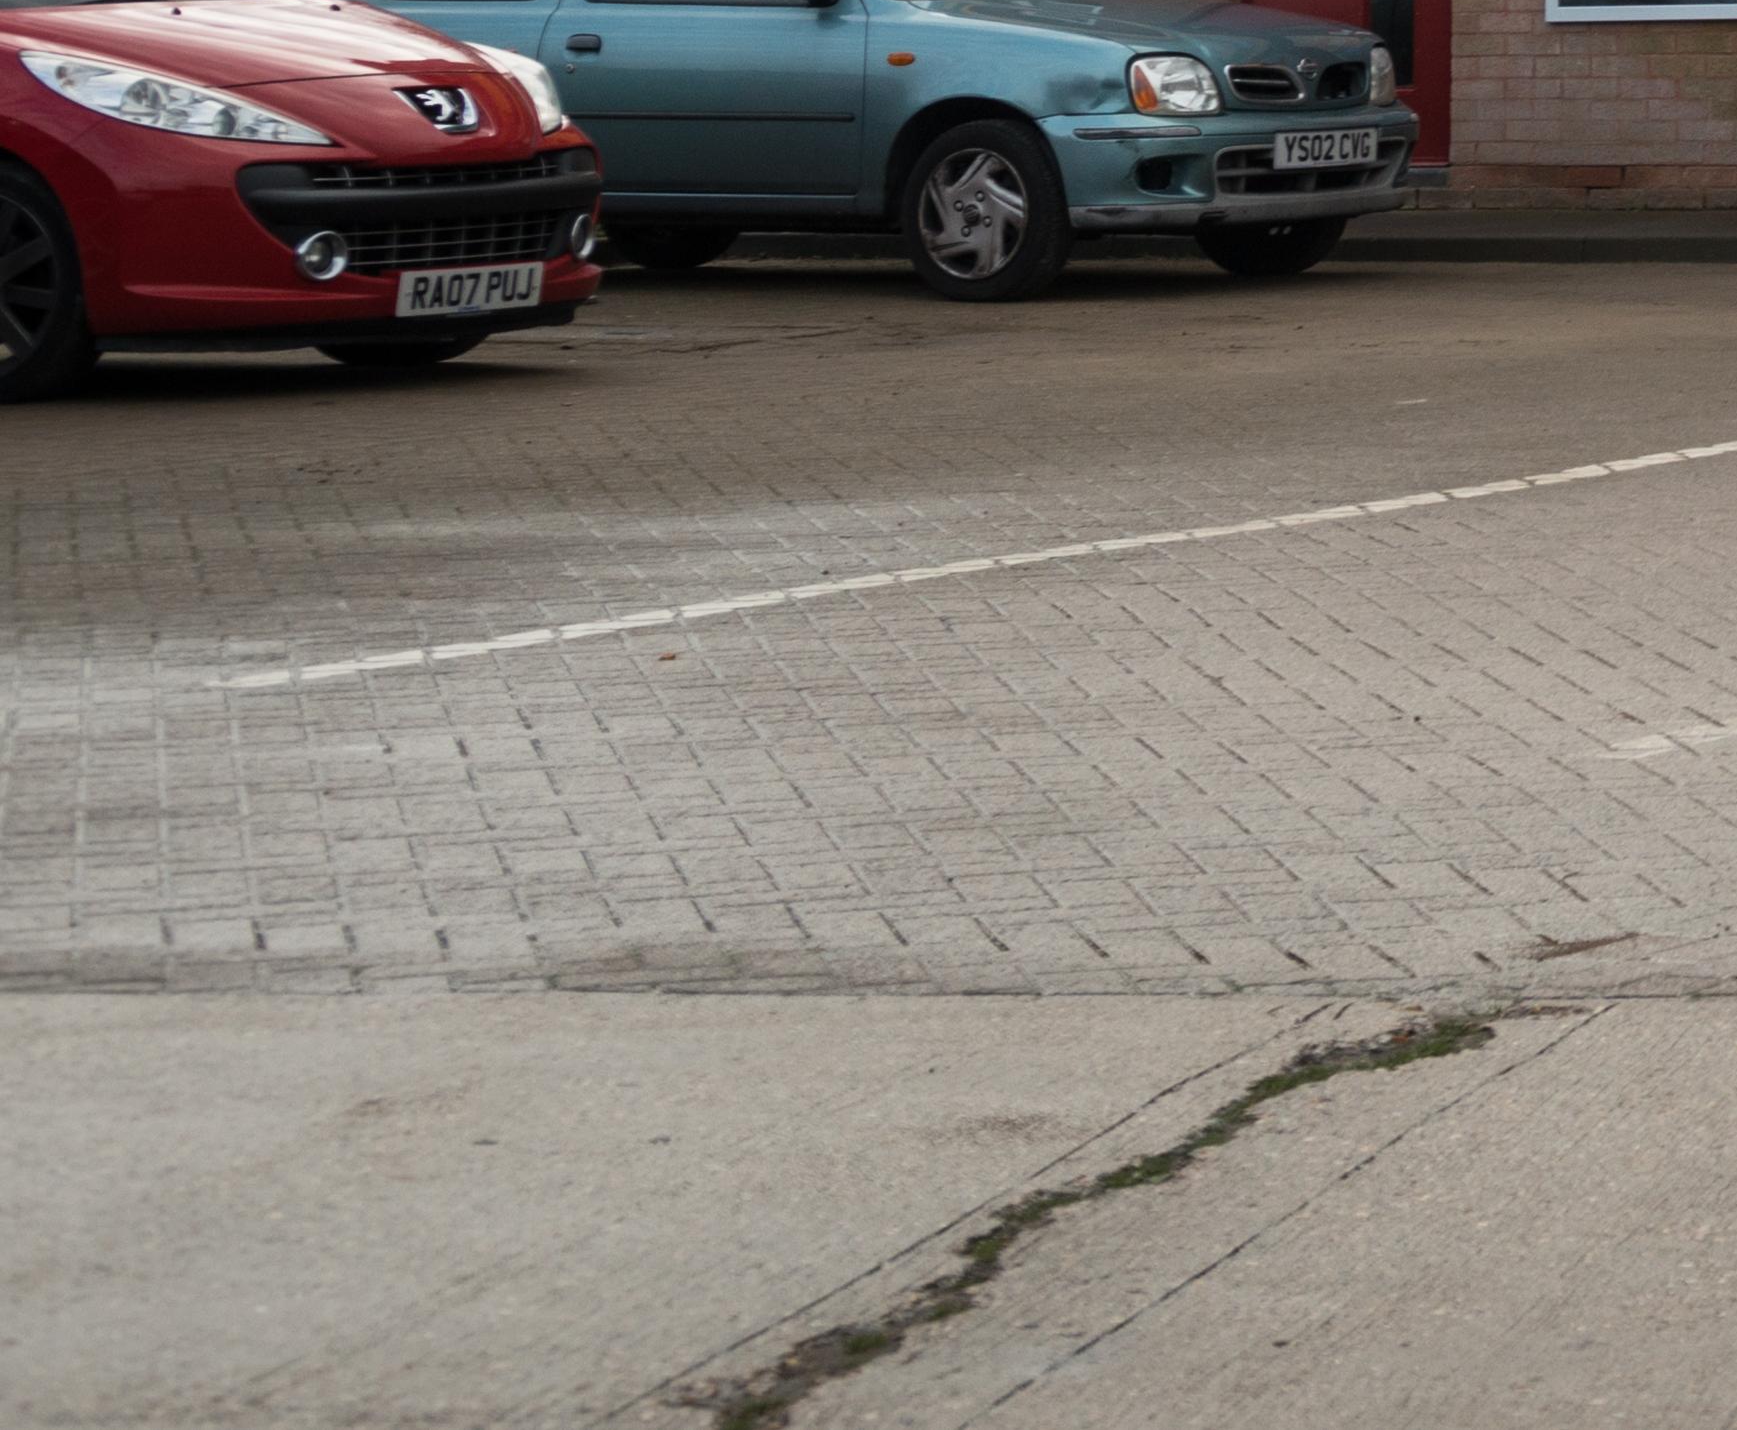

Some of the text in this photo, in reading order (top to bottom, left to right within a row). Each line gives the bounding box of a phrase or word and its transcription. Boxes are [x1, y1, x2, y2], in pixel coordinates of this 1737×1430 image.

[1284, 131, 1371, 162] YS02 CVG
[410, 267, 535, 310] RA07 PUJ
